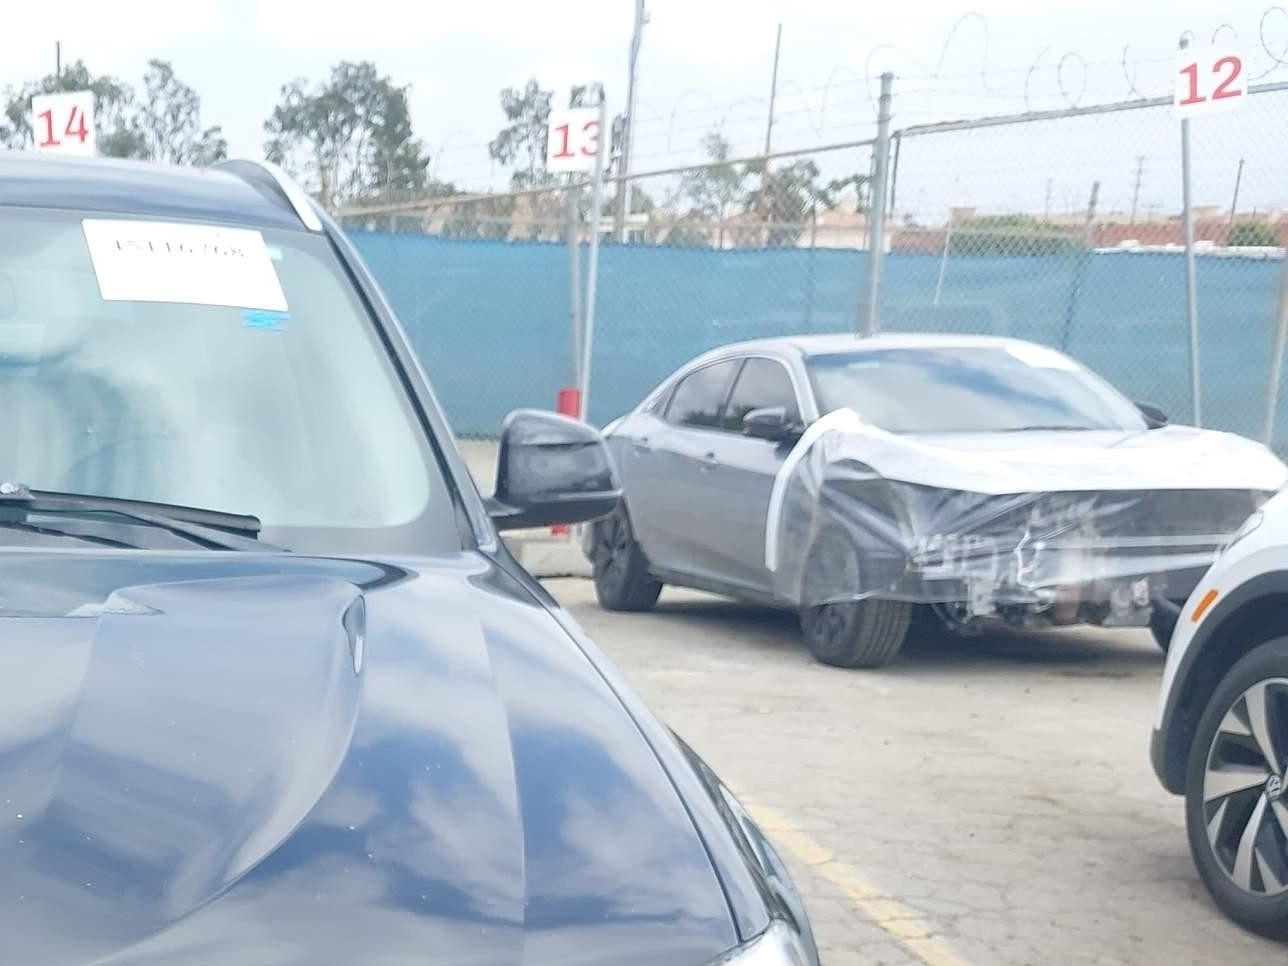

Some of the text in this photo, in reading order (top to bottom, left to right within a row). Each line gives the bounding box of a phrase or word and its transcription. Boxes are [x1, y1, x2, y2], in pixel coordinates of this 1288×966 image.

[1179, 55, 1242, 105] 12
[38, 106, 89, 147] 14
[553, 121, 600, 158] 13
